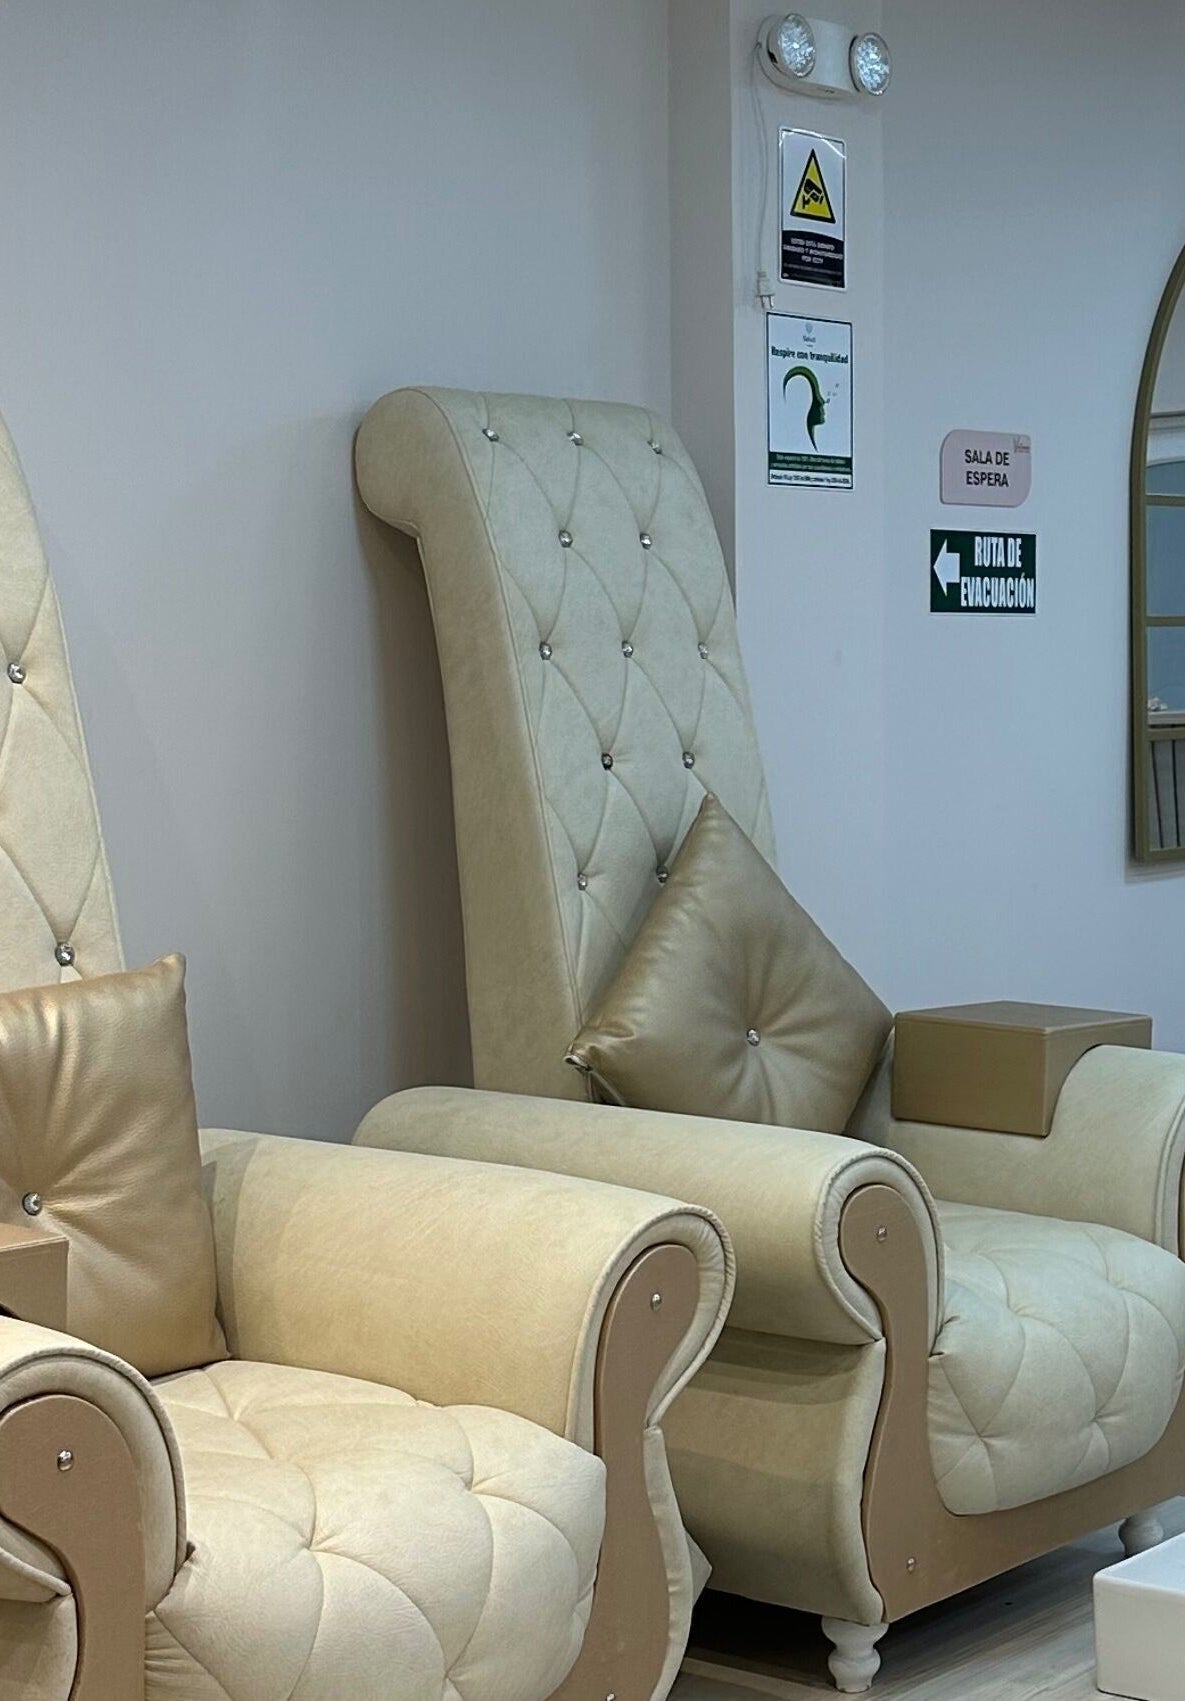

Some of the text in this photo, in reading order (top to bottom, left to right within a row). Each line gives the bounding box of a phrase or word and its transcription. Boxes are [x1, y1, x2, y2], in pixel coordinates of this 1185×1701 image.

[965, 449, 1010, 466] SALA DE
[966, 471, 1009, 487] ESPERA
[974, 536, 1022, 568] RUTA DE
[961, 573, 1034, 608] EVACUACIÓN
